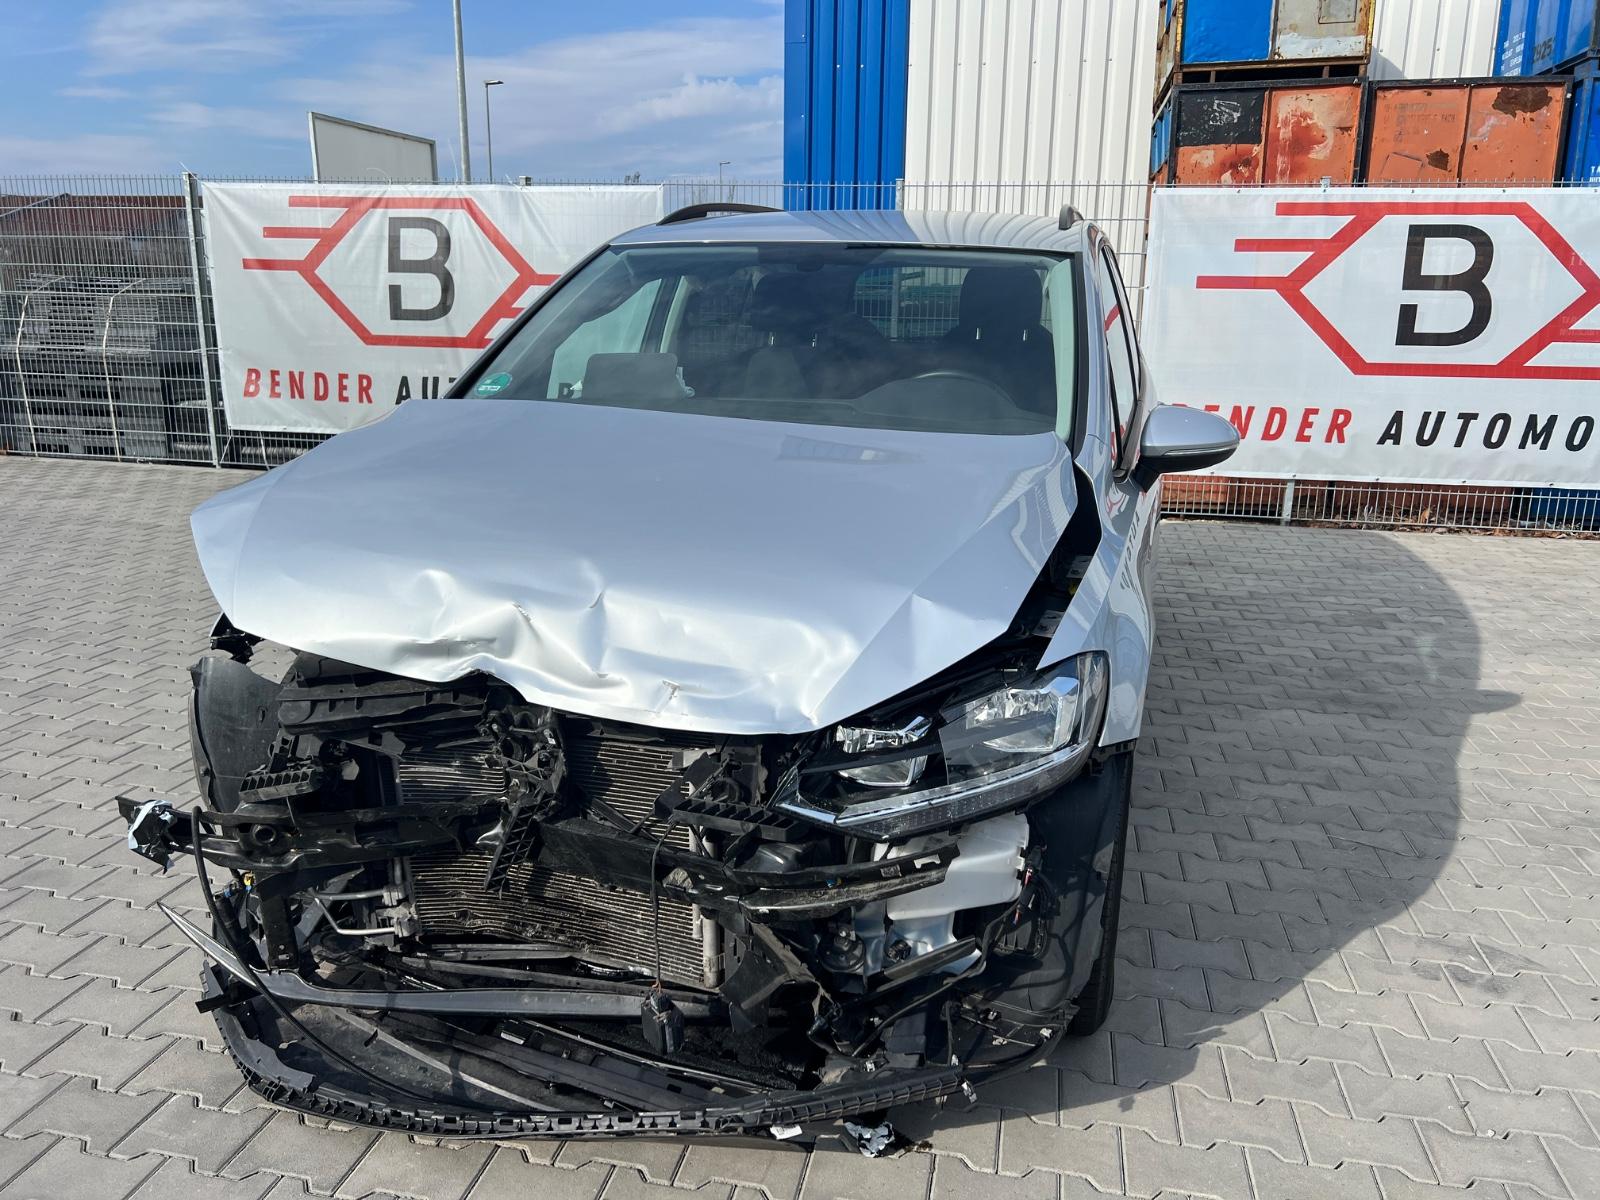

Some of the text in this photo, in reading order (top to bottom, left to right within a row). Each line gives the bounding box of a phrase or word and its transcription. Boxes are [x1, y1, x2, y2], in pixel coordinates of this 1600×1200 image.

[388, 216, 456, 321] B
[1395, 223, 1495, 347] B
[243, 367, 458, 405] BENDER AU
[1171, 403, 1596, 452] NDER AUTOMO
